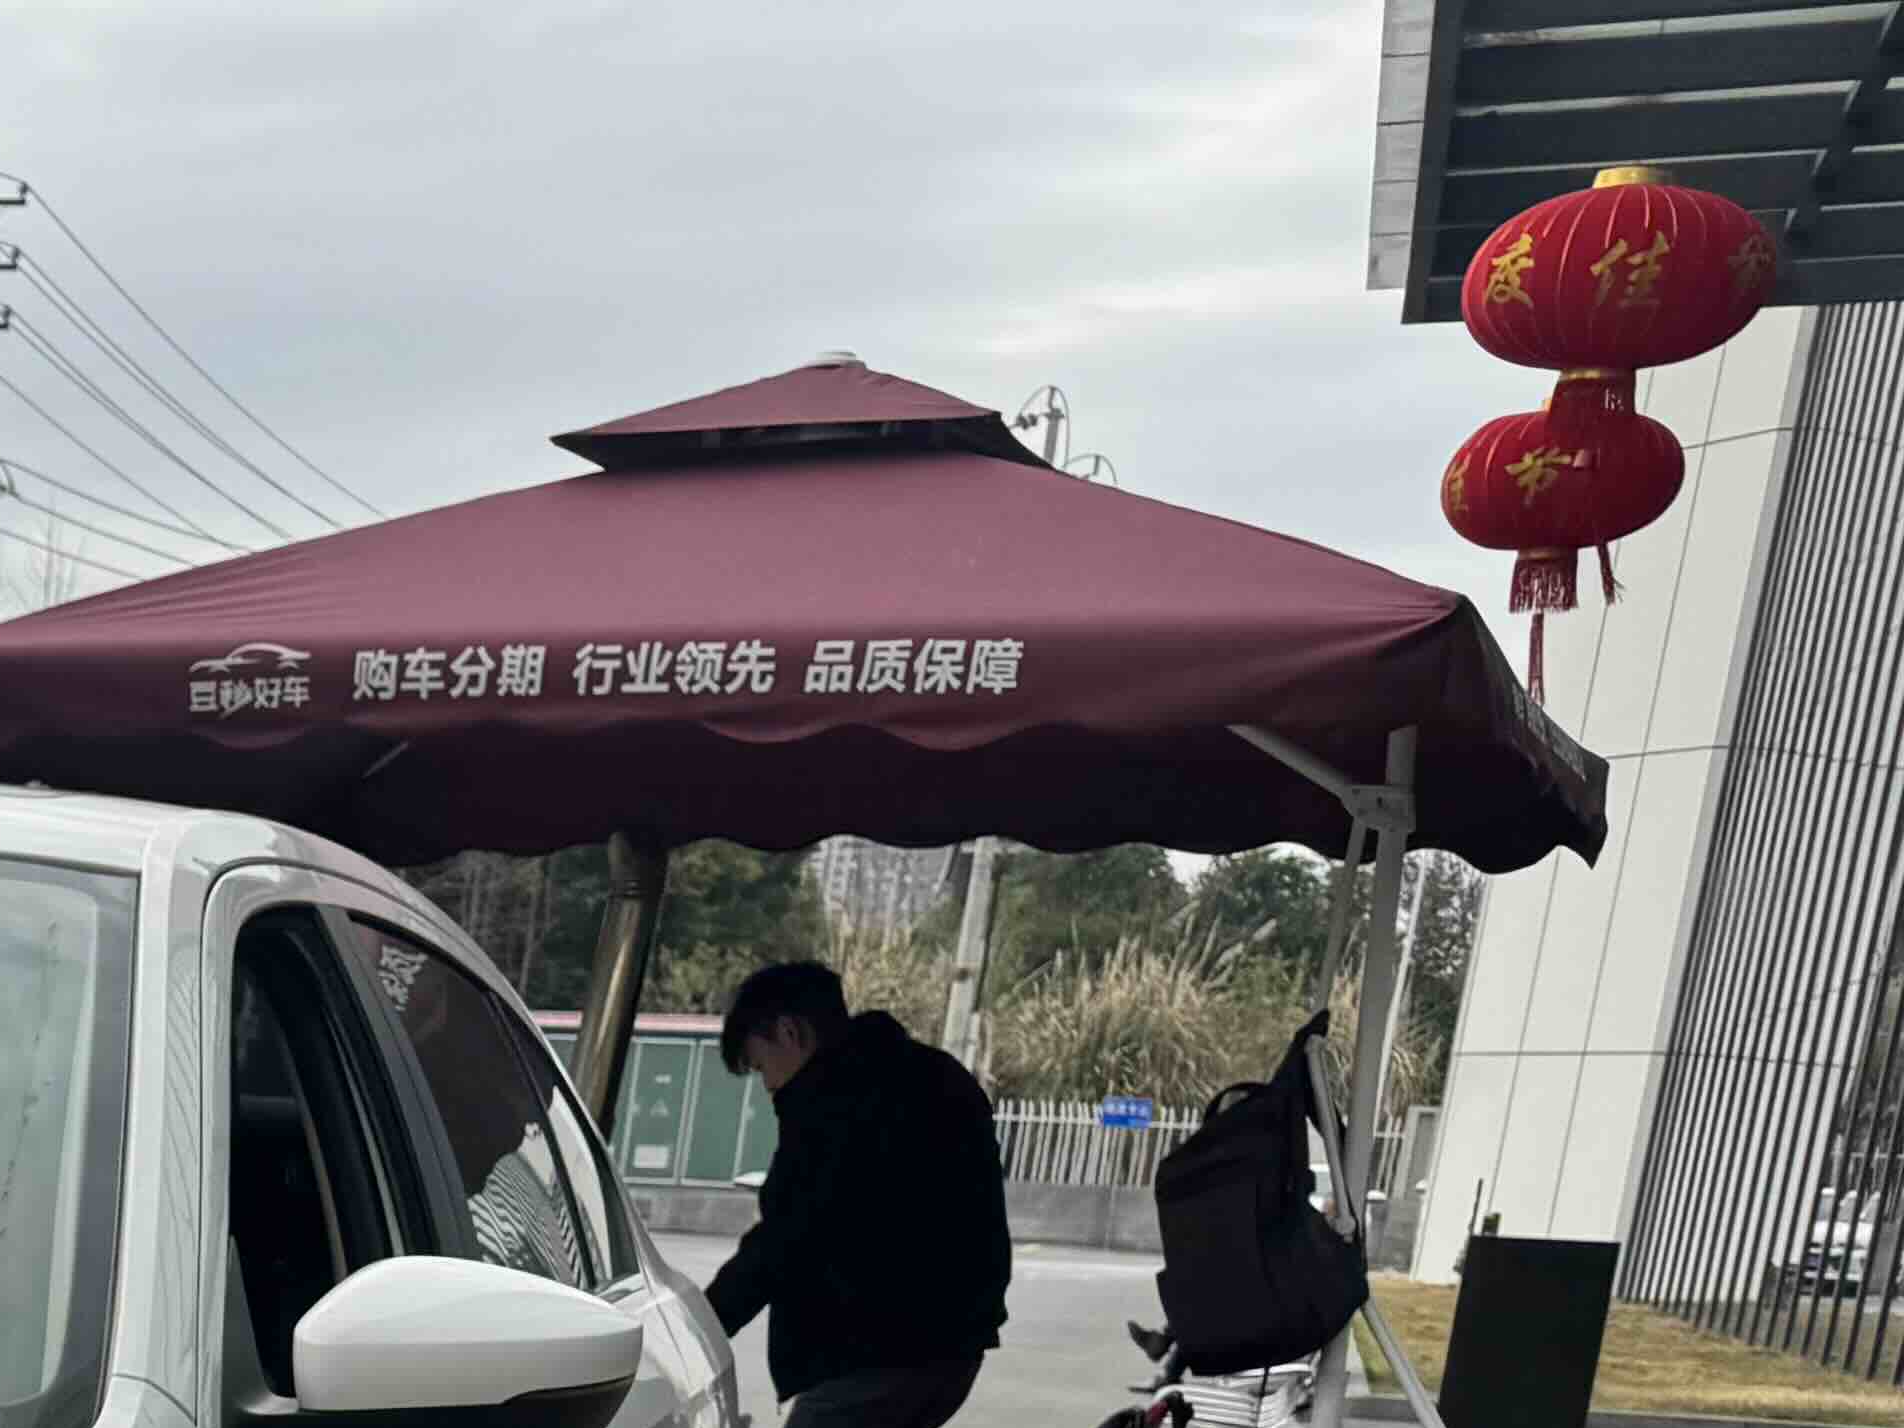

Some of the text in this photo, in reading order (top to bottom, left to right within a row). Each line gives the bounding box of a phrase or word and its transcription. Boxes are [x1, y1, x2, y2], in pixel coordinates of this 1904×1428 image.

[352, 645, 546, 699] 购车分期
[572, 641, 776, 695] 行业领先
[804, 638, 1024, 695] 品质保障
